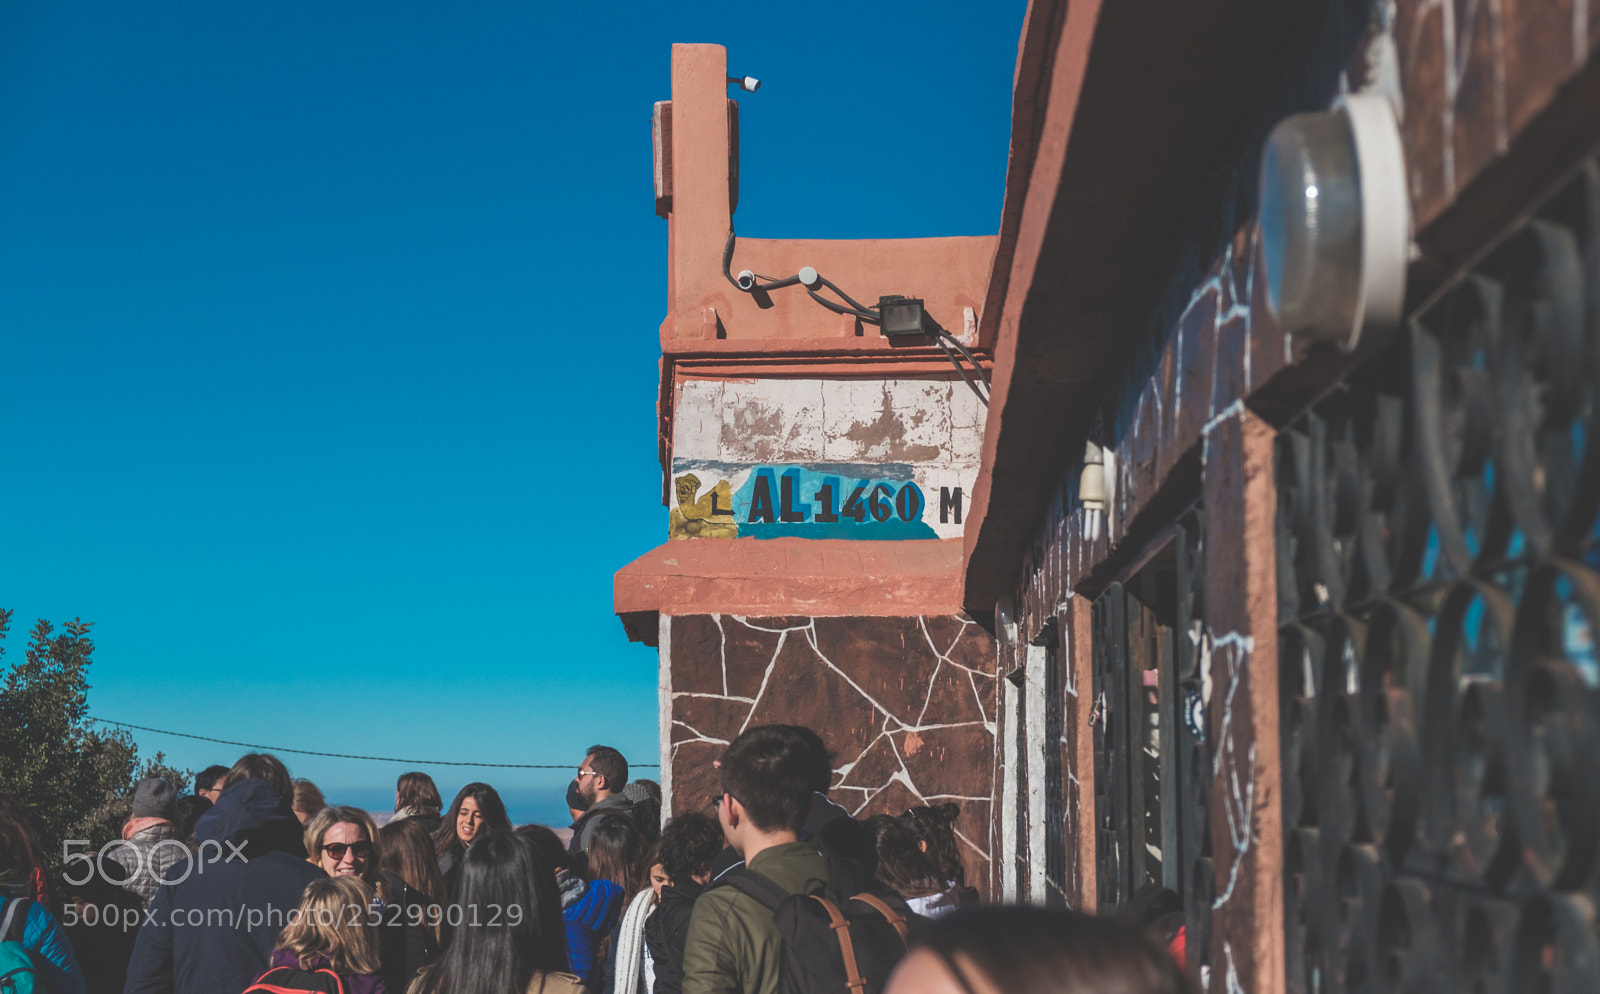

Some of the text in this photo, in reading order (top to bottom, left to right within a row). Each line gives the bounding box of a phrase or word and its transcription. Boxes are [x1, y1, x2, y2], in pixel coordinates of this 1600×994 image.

[748, 471, 962, 524] AL 1460 M
